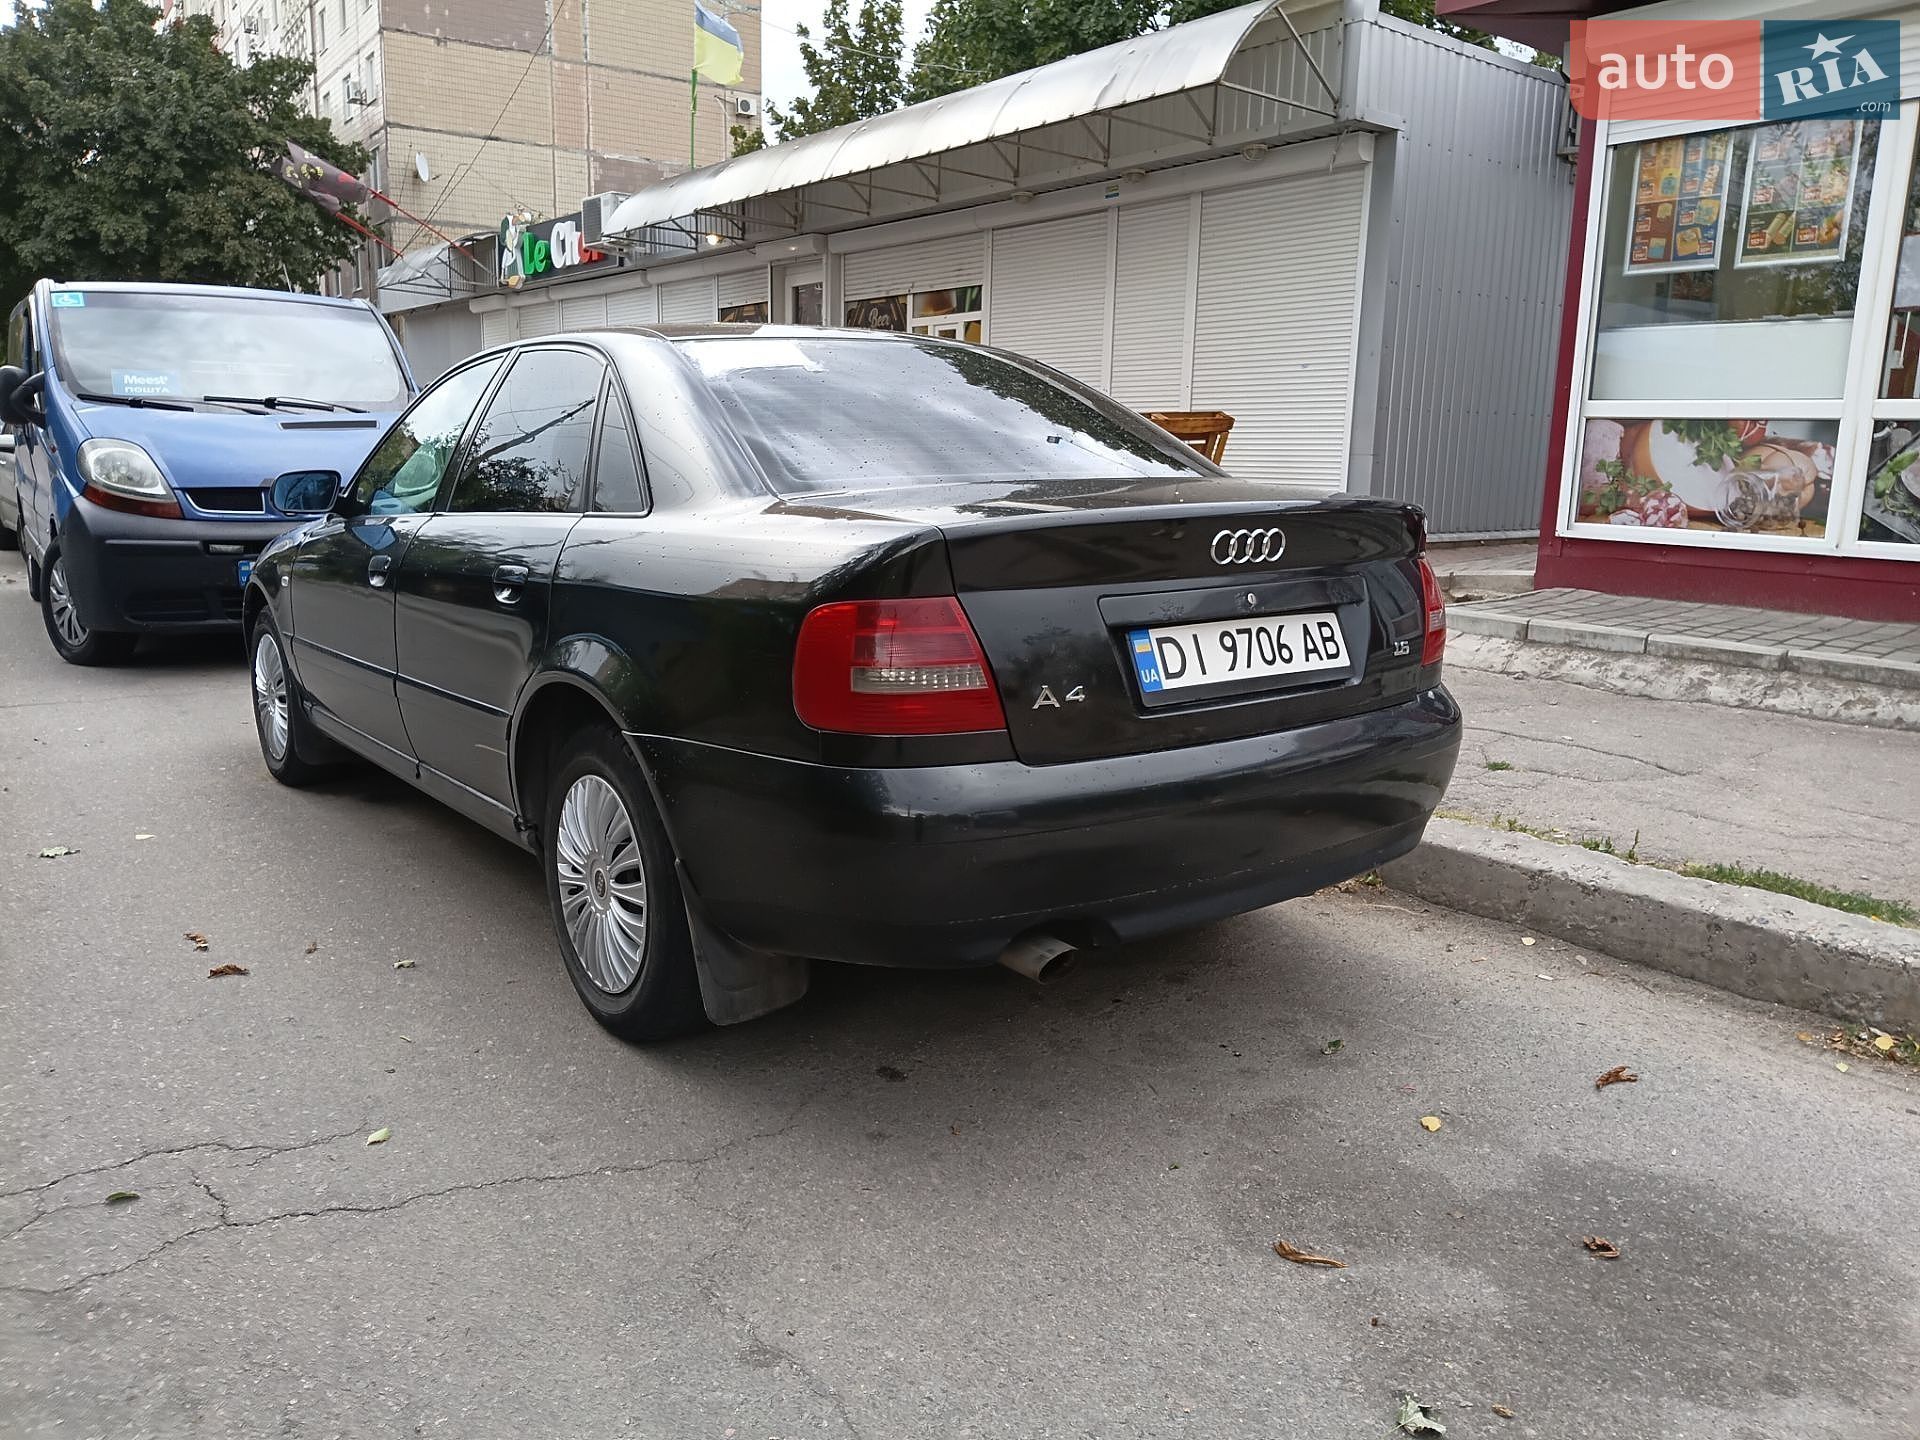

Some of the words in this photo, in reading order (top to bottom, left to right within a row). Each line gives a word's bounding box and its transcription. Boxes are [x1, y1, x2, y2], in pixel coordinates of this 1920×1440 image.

[523, 231, 550, 275] Le
[1156, 633, 1207, 681] DI
[1219, 624, 1293, 672] 9706
[1302, 620, 1340, 663] AB
[1141, 669, 1160, 683] UA
